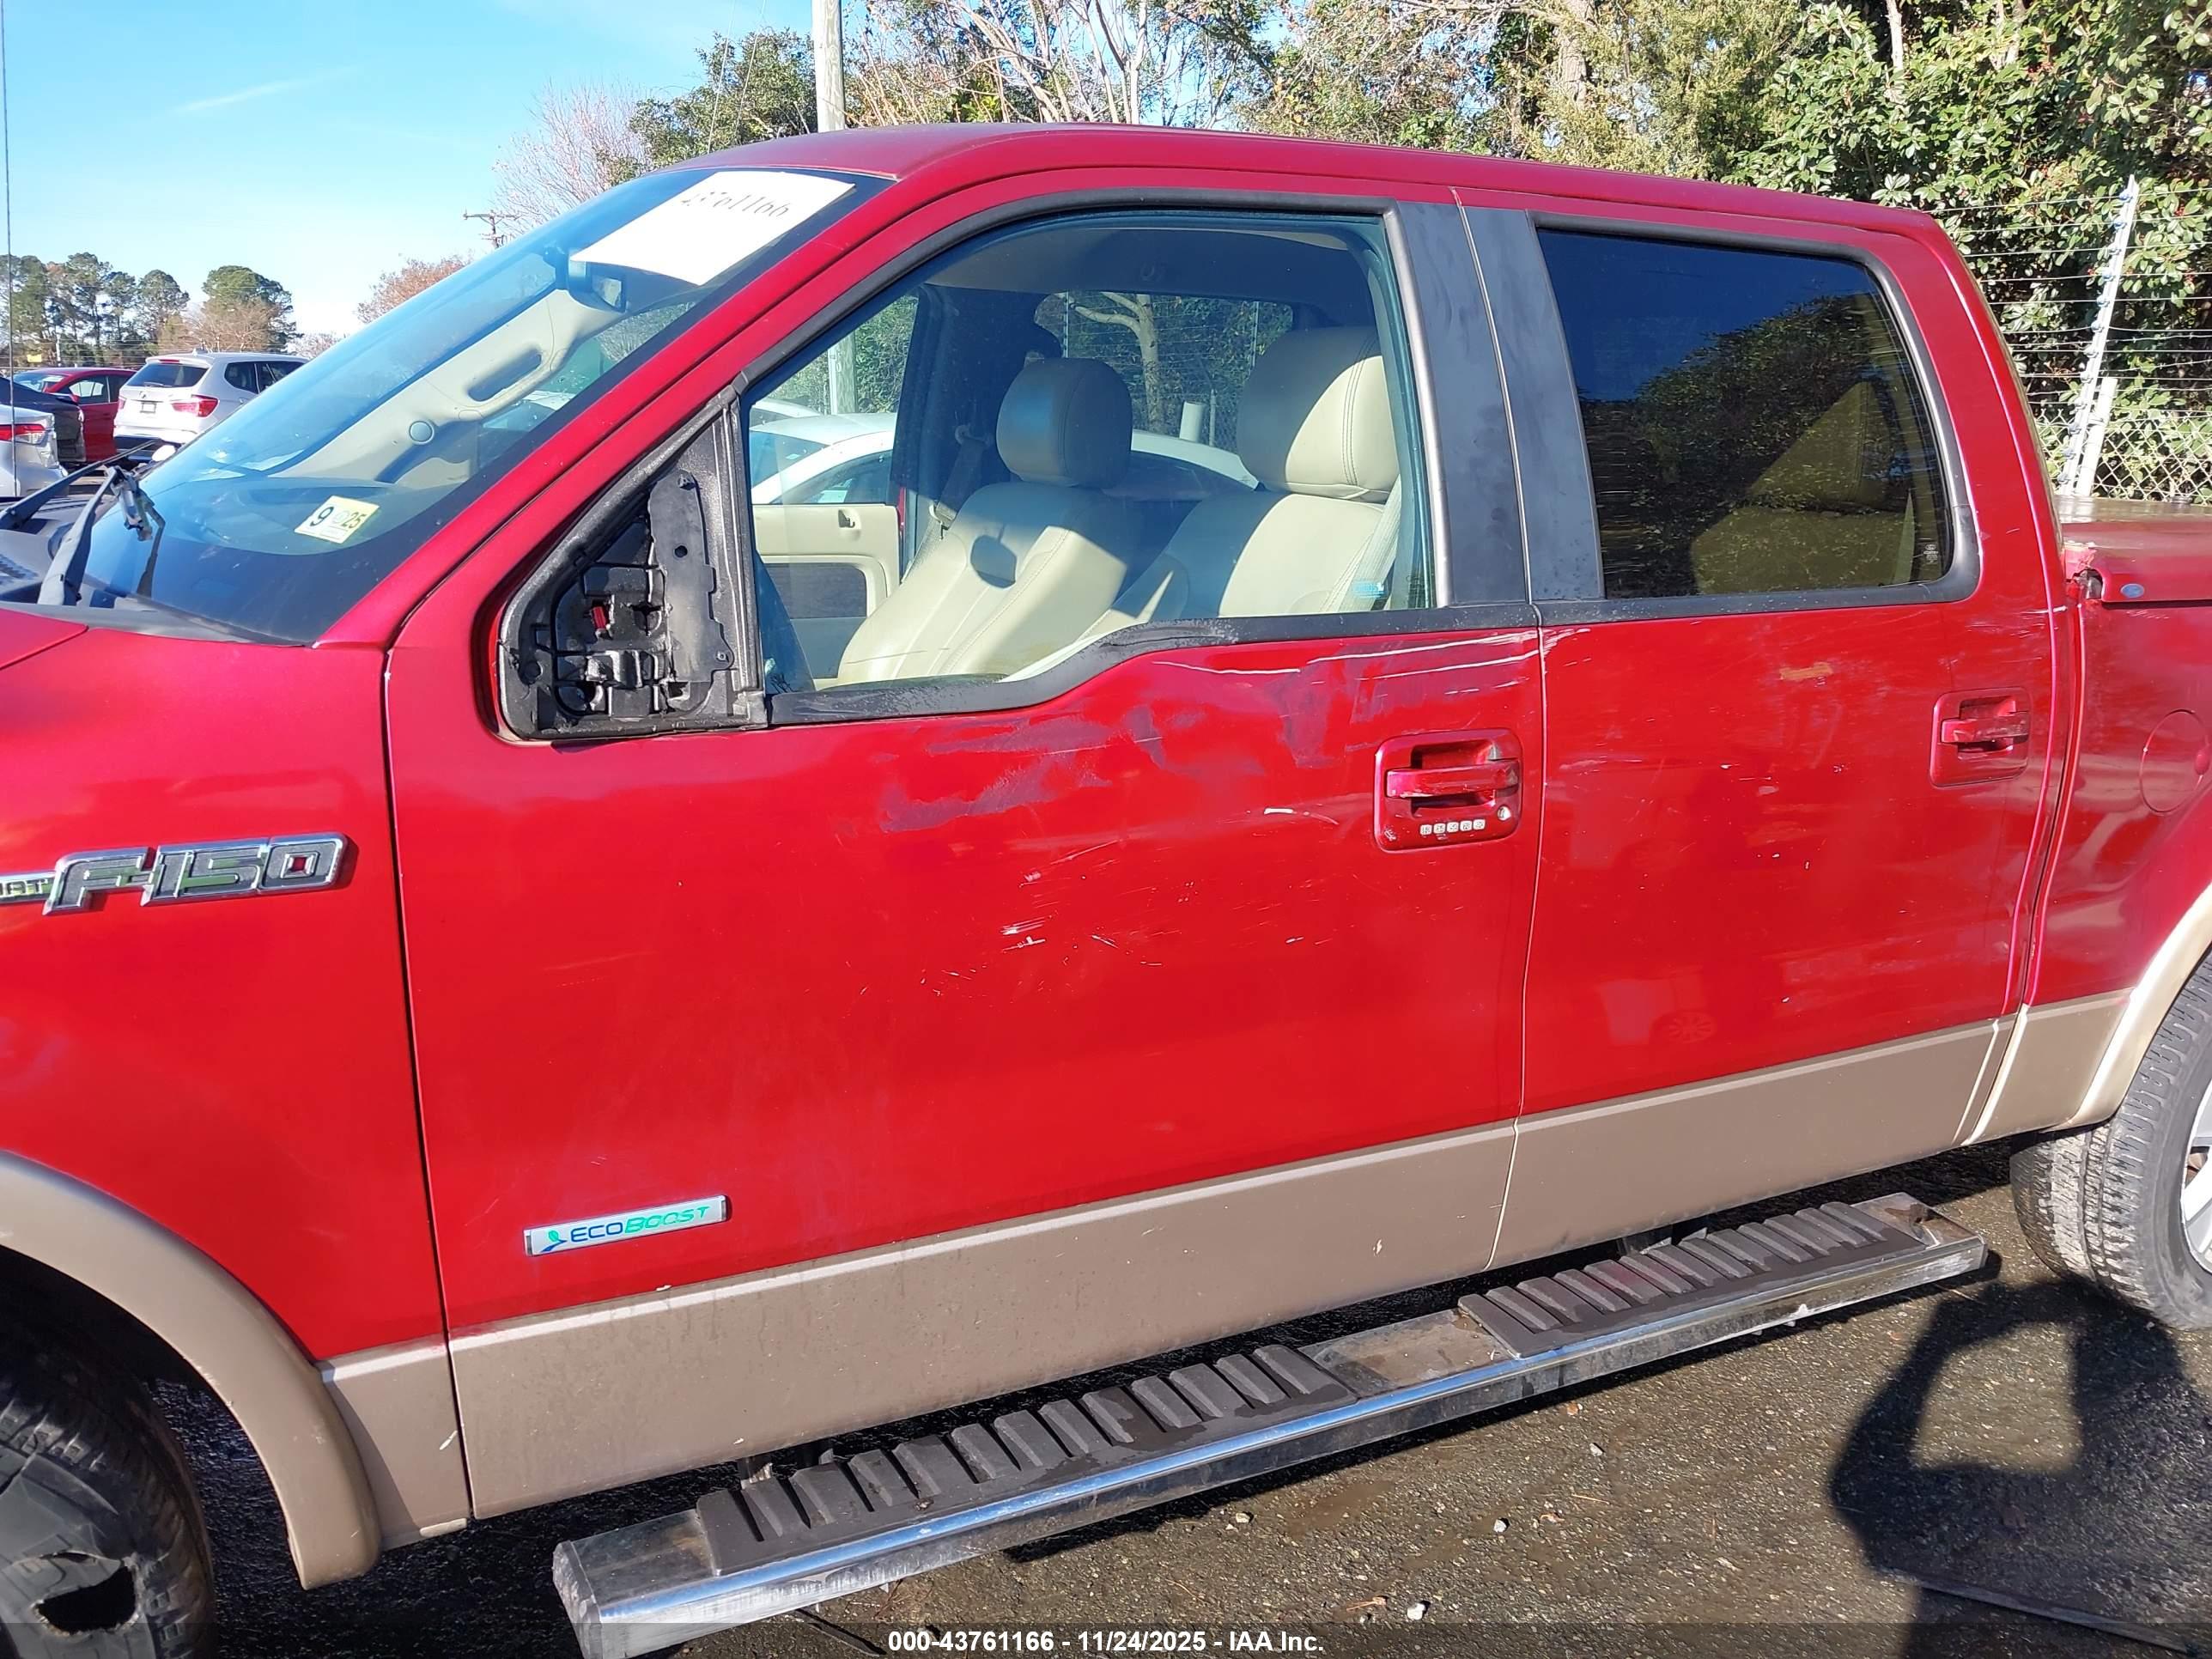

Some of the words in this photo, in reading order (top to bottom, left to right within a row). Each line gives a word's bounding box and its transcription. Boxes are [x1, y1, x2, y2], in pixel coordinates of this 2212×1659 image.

[310, 507, 334, 526] 9
[341, 512, 367, 529] 25
[42, 832, 348, 916] F-150
[571, 1206, 709, 1243] ECOBOOST
